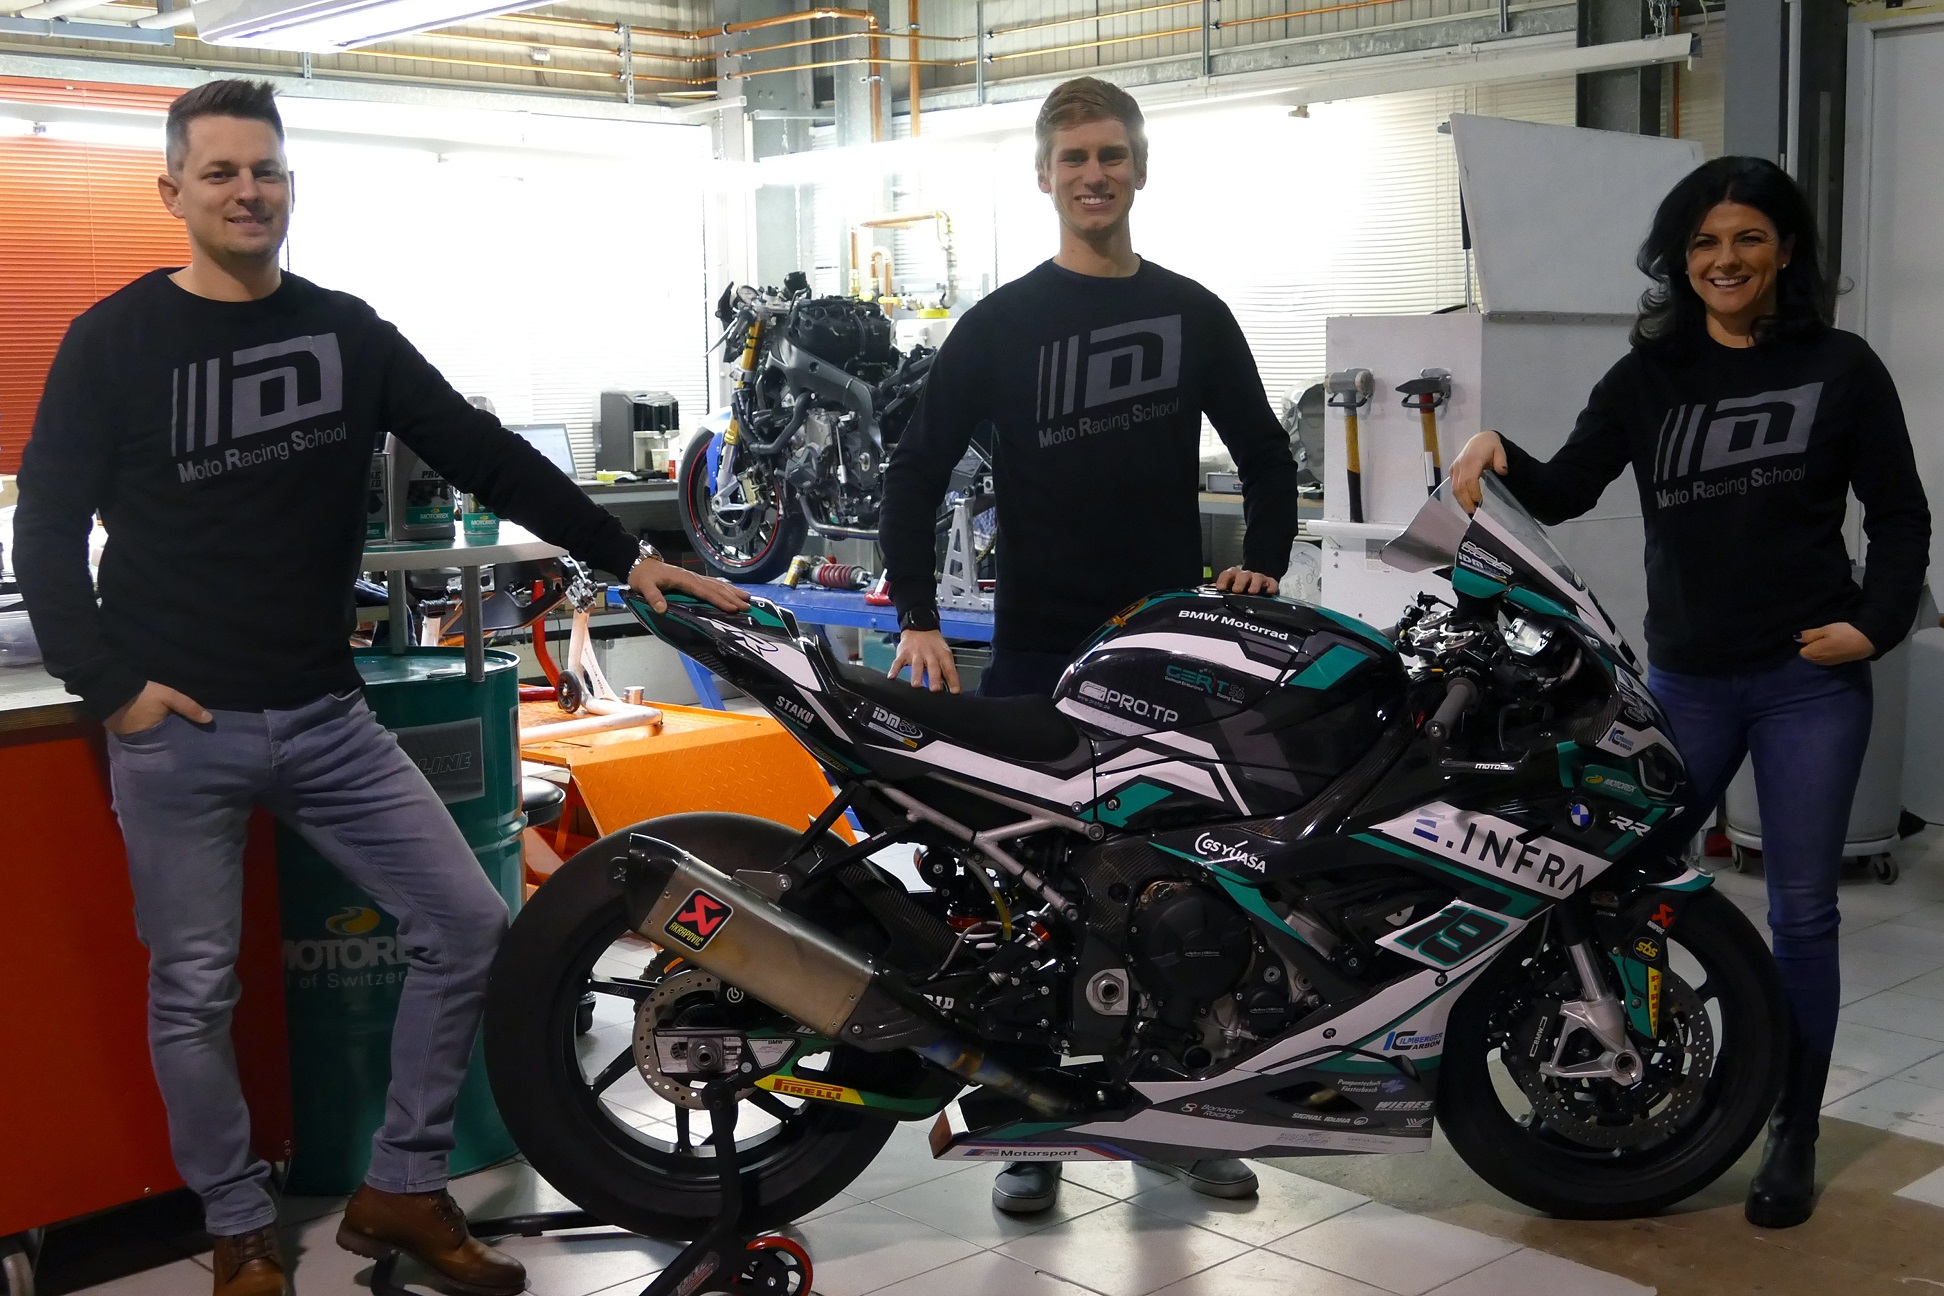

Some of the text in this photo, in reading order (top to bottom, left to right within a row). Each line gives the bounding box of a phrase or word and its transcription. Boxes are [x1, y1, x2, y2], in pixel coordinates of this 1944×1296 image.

[1038, 397, 1179, 448] Moto Racing School
[177, 422, 347, 483] Moto Racing School
[1656, 464, 1806, 509] Moto Racing School
[1178, 609, 1289, 641] BMW Motorrad
[775, 695, 814, 724] STAKU
[1106, 689, 1179, 723] PRO.TP
[1604, 779, 1636, 793] MOTOREX
[1610, 815, 1651, 837] RR
[300, 972, 319, 989] of
[773, 1078, 844, 1100] PIRELLI
[1291, 1112, 1322, 1121] SIGNAL
